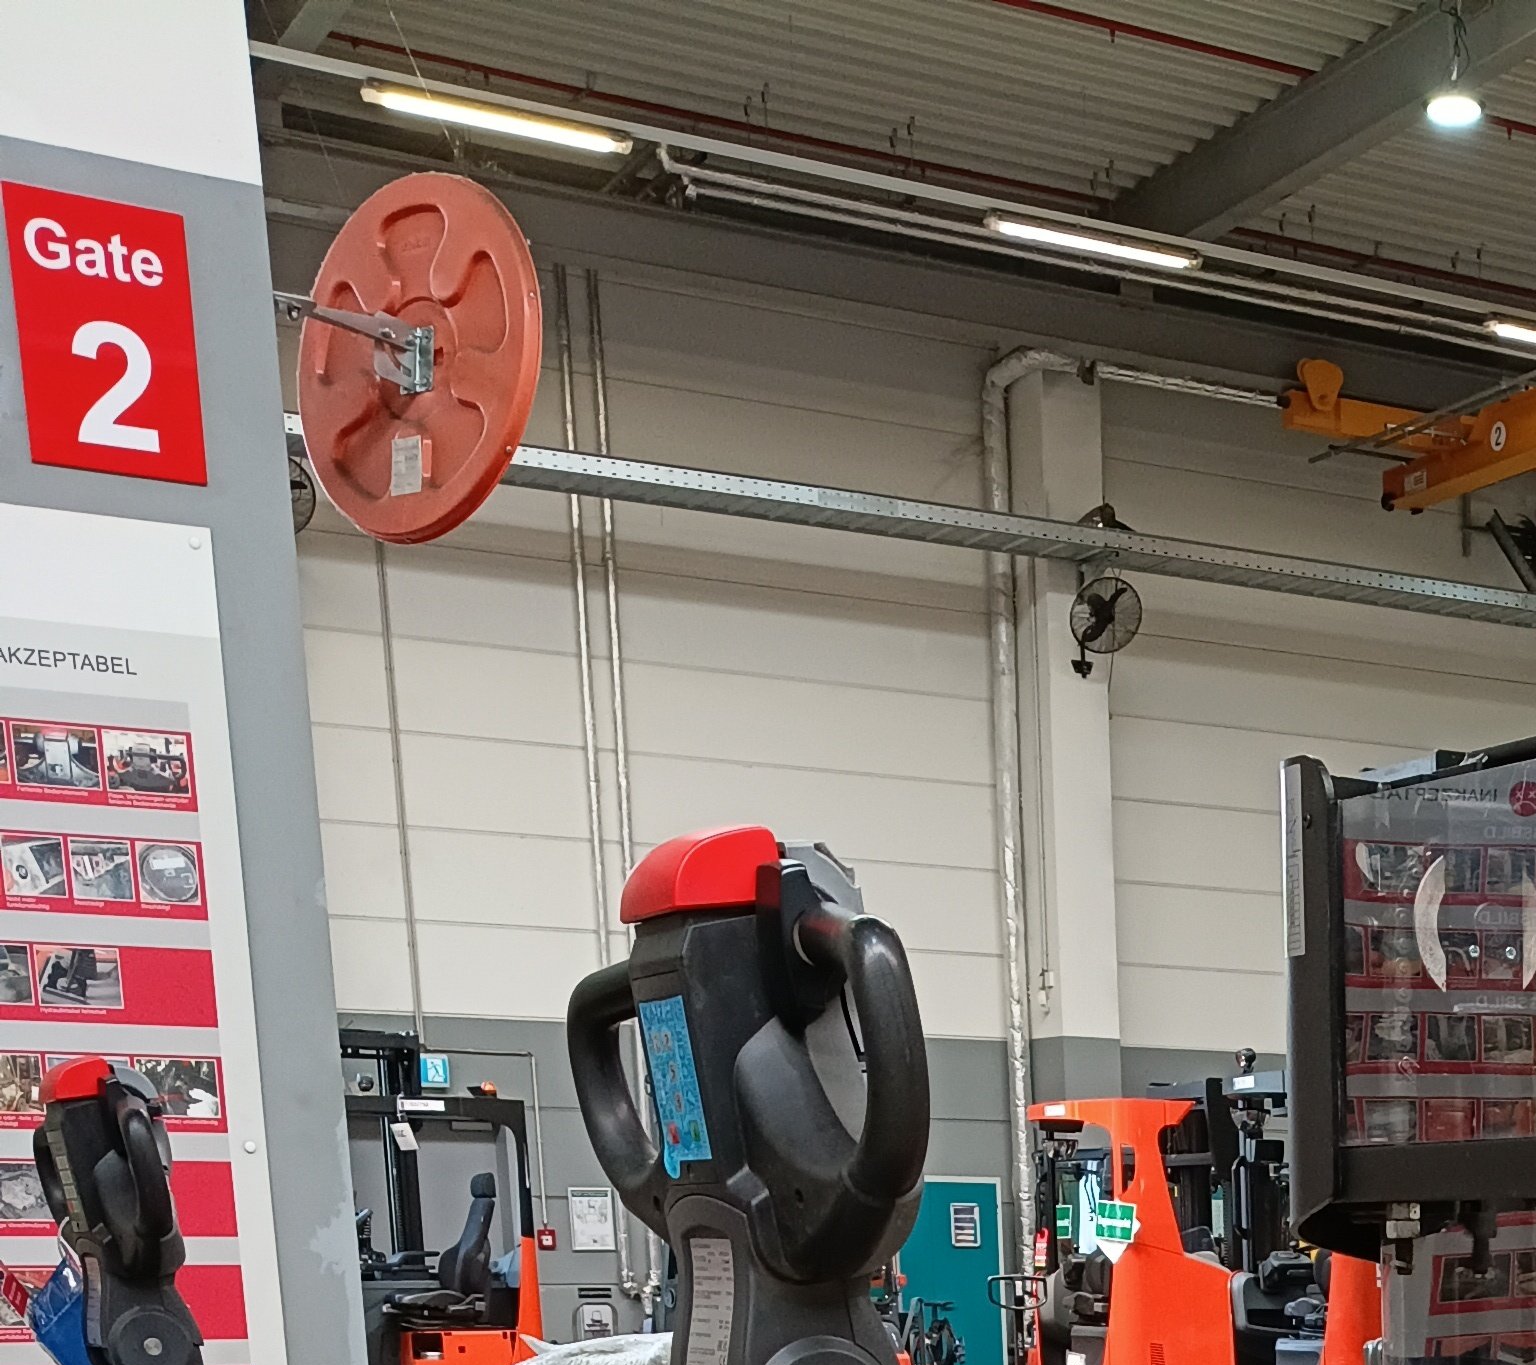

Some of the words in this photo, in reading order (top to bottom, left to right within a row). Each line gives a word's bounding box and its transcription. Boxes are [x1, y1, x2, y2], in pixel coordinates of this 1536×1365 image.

[23, 217, 164, 287] Gate
[71, 320, 161, 453] 2
[1494, 426, 1503, 447] 2
